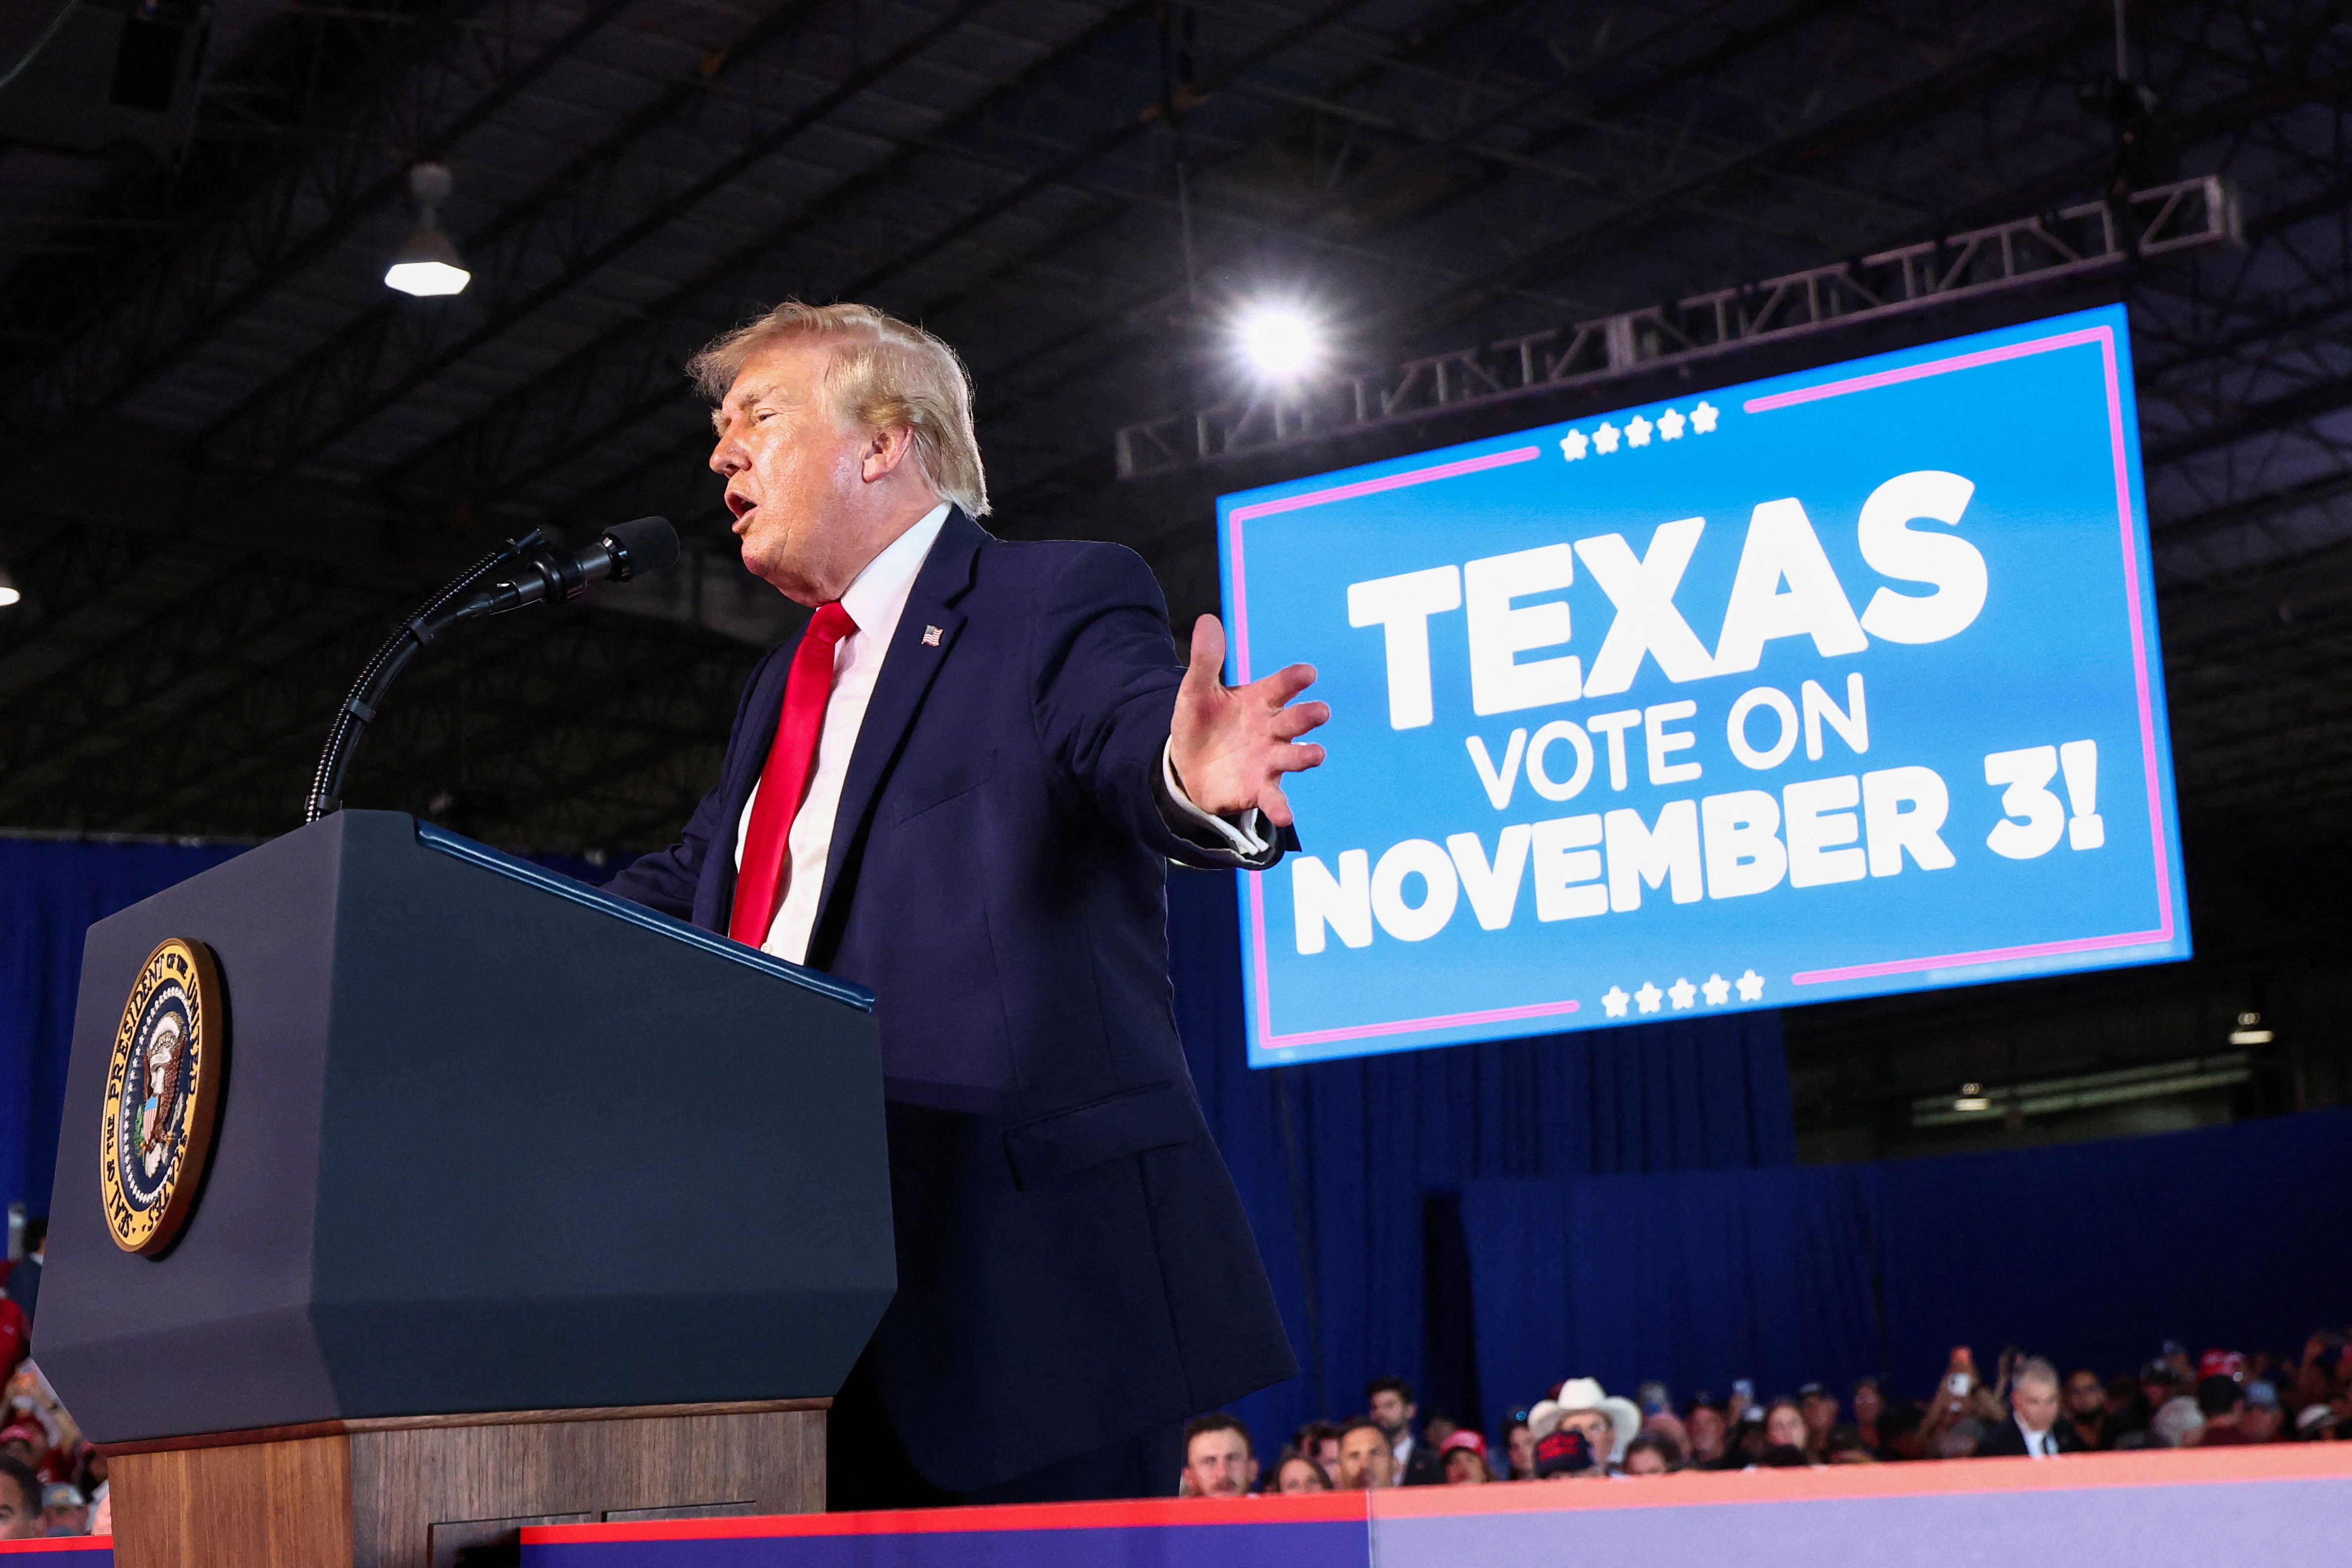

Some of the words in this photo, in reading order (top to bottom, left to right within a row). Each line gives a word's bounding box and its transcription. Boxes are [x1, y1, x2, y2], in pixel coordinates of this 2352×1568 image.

[1346, 470, 1989, 731] TEXAS
[1465, 699, 1703, 810] VOTE
[1726, 671, 1869, 771] ON
[1291, 765, 1957, 956] NOVEMBER
[1983, 738, 2105, 860] 3!
[108, 953, 165, 1101] PRESIDENT
[106, 1114, 115, 1155] THE
[109, 1180, 133, 1238] SEAL
